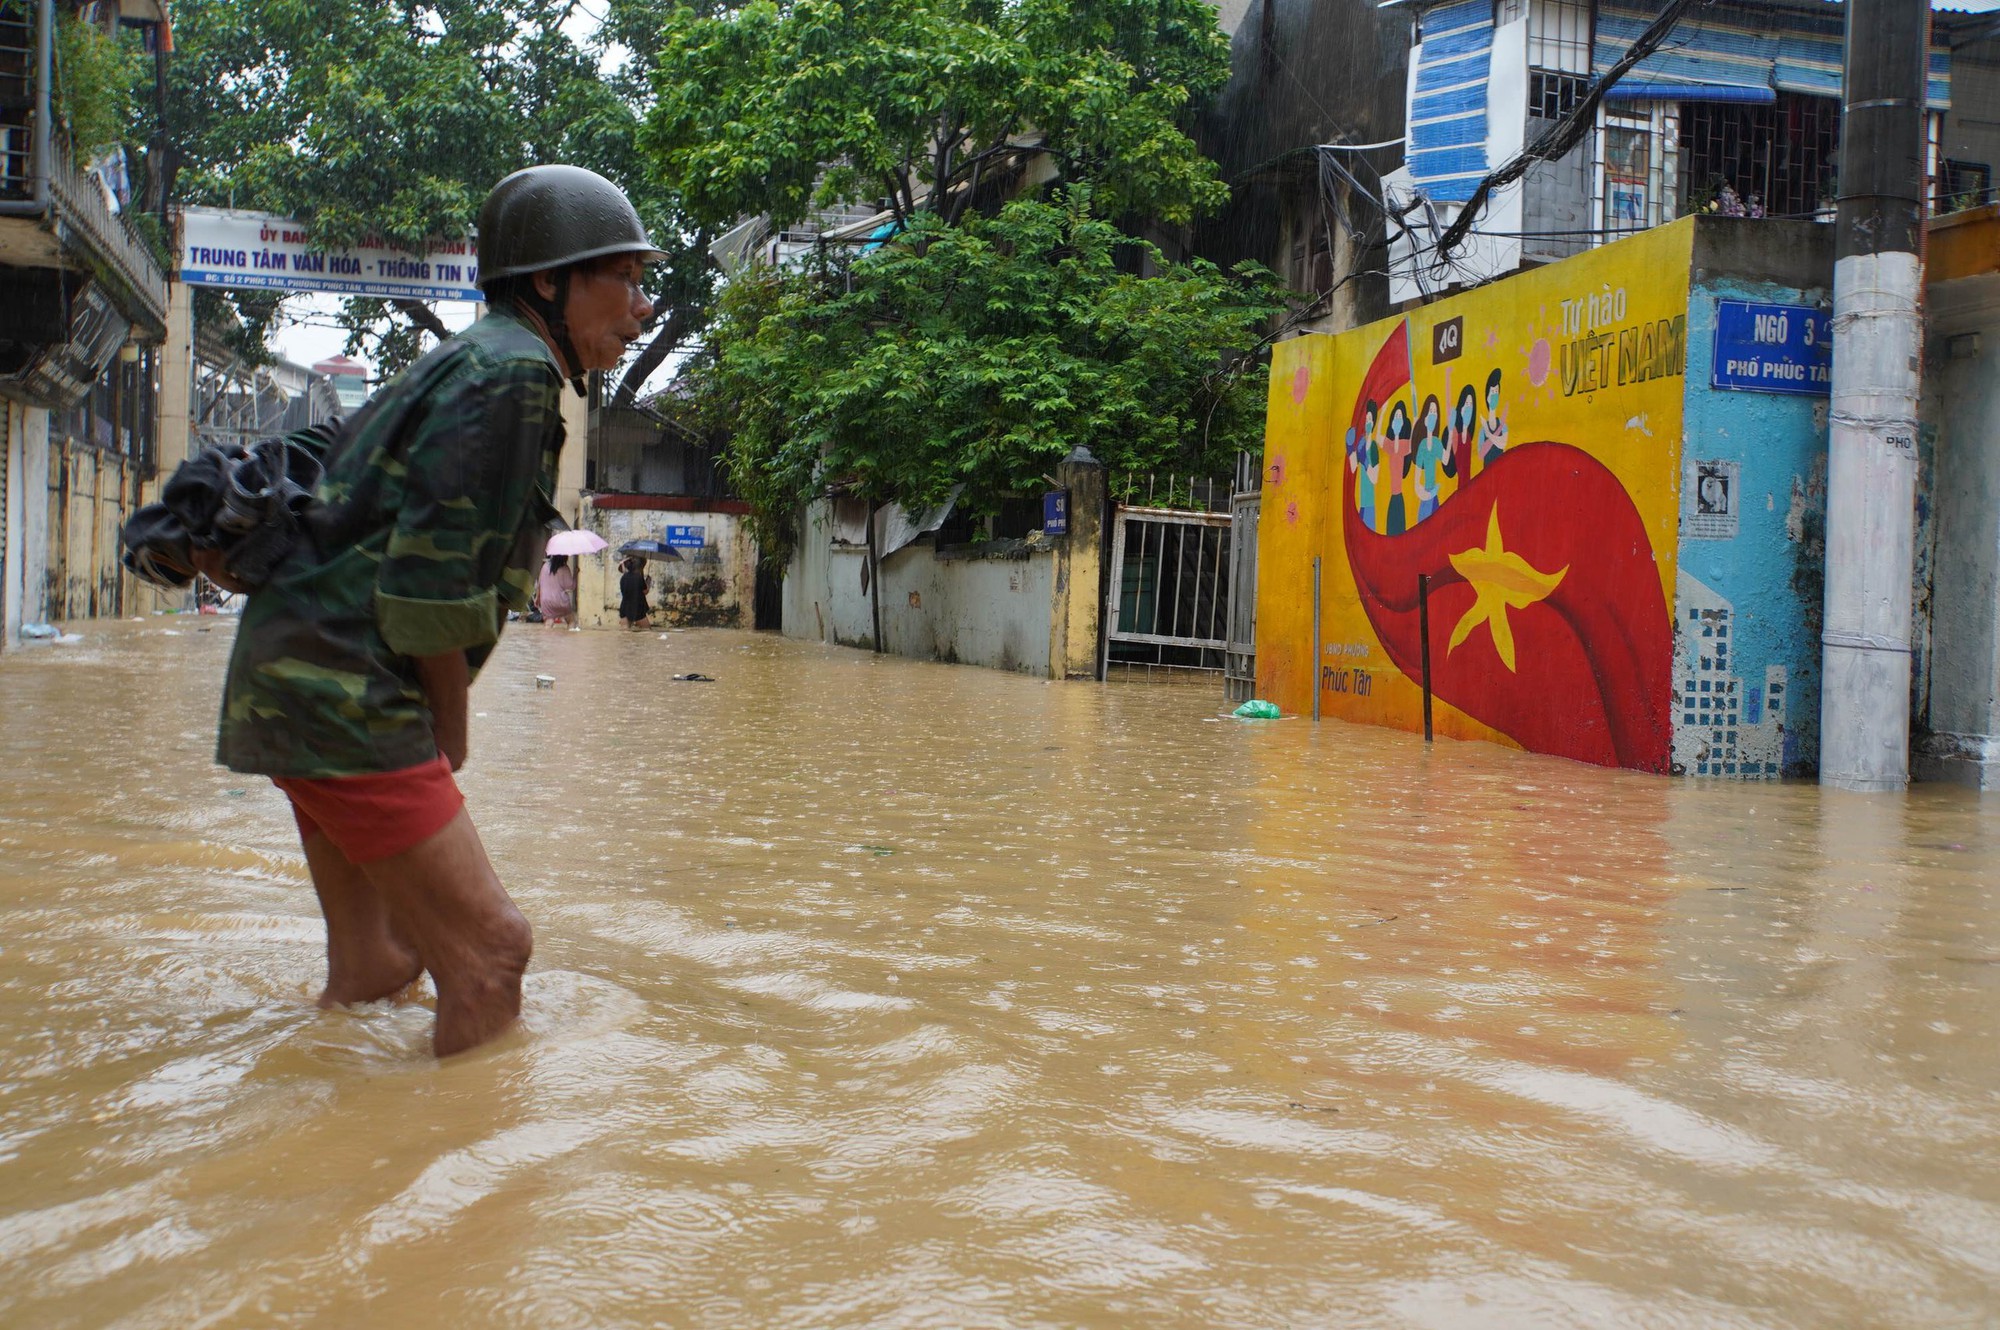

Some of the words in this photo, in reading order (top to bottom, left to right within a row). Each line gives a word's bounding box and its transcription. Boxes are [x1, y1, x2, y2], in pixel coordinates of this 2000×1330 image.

[260, 223, 278, 242] ỦY
[282, 229, 308, 244] BAN
[190, 246, 247, 268] TRUNG
[252, 247, 286, 270] TÂM
[329, 252, 362, 275] HÓA
[377, 256, 431, 281] THÔNG
[436, 264, 461, 282] TIN
[467, 265, 477, 283] V
[223, 273, 236, 283] SỐ
[237, 275, 243, 284] 2
[244, 275, 267, 286] PHÚC
[322, 281, 345, 291] PHÚC
[1560, 298, 1584, 341] Tự
[1588, 282, 1626, 330] hào
[1754, 310, 1788, 344] NGÕ
[1560, 329, 1615, 404] VIỆT
[1618, 313, 1685, 386] NAM
[1726, 355, 1761, 378] PHỐ
[1762, 360, 1805, 381] PHÚC
[1047, 517, 1057, 528] PHỐ
[1321, 665, 1348, 693] Phúc
[1353, 668, 1372, 697] Tân
